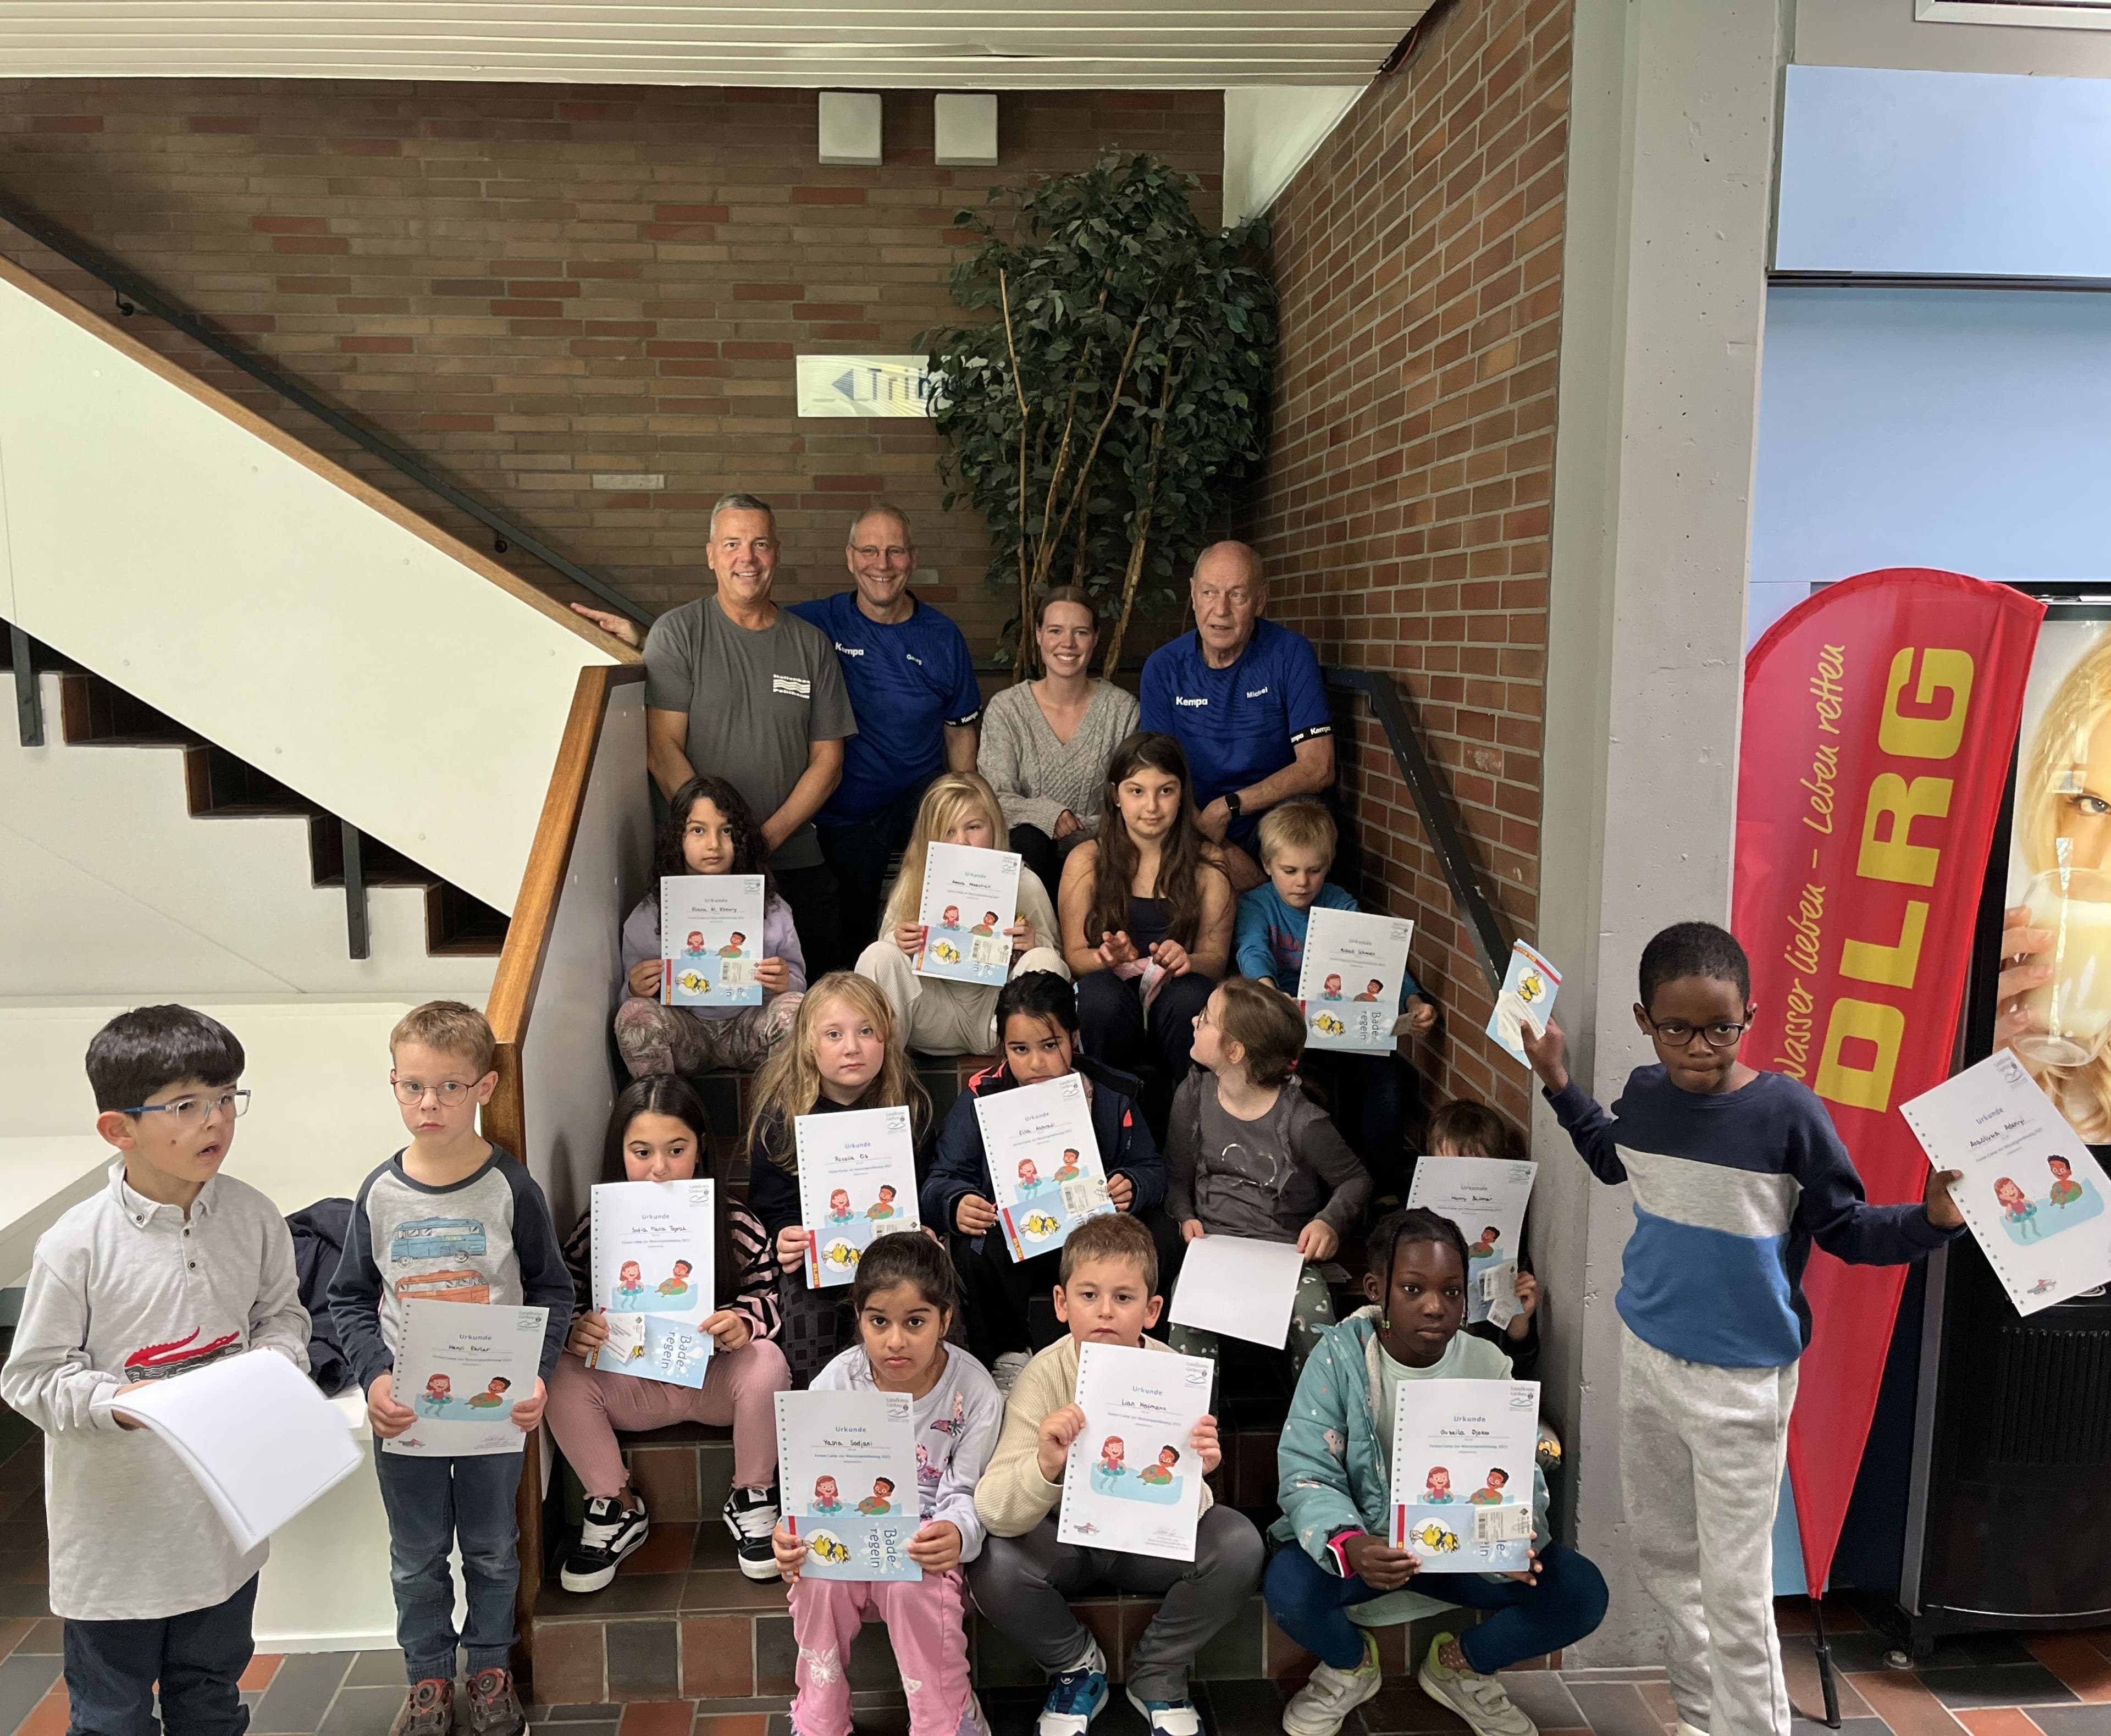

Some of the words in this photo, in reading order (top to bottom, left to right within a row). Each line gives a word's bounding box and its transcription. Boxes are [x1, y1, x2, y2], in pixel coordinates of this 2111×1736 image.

[835, 642, 864, 657] Kempa
[1176, 696, 1208, 707] Kempa
[1810, 644, 1845, 734] retten
[1310, 726, 1331, 735] Kempa
[1800, 744, 1839, 834] Leben
[1814, 647, 1974, 1112] DLRG
[1784, 883, 1826, 974] lieben
[1359, 1011, 1368, 1040] regeln
[1773, 978, 1814, 1081] Wasser
[1976, 1108, 2004, 1124] Urkunde
[661, 1331, 676, 1369] regeln
[676, 1335, 692, 1370] Bade-
[1121, 1398, 1135, 1407] Lian
[1140, 1402, 1167, 1411] Hofmann
[1132, 1386, 1163, 1396] Urkunde
[869, 1529, 881, 1568] regeln
[884, 1528, 897, 1567] Bade-
